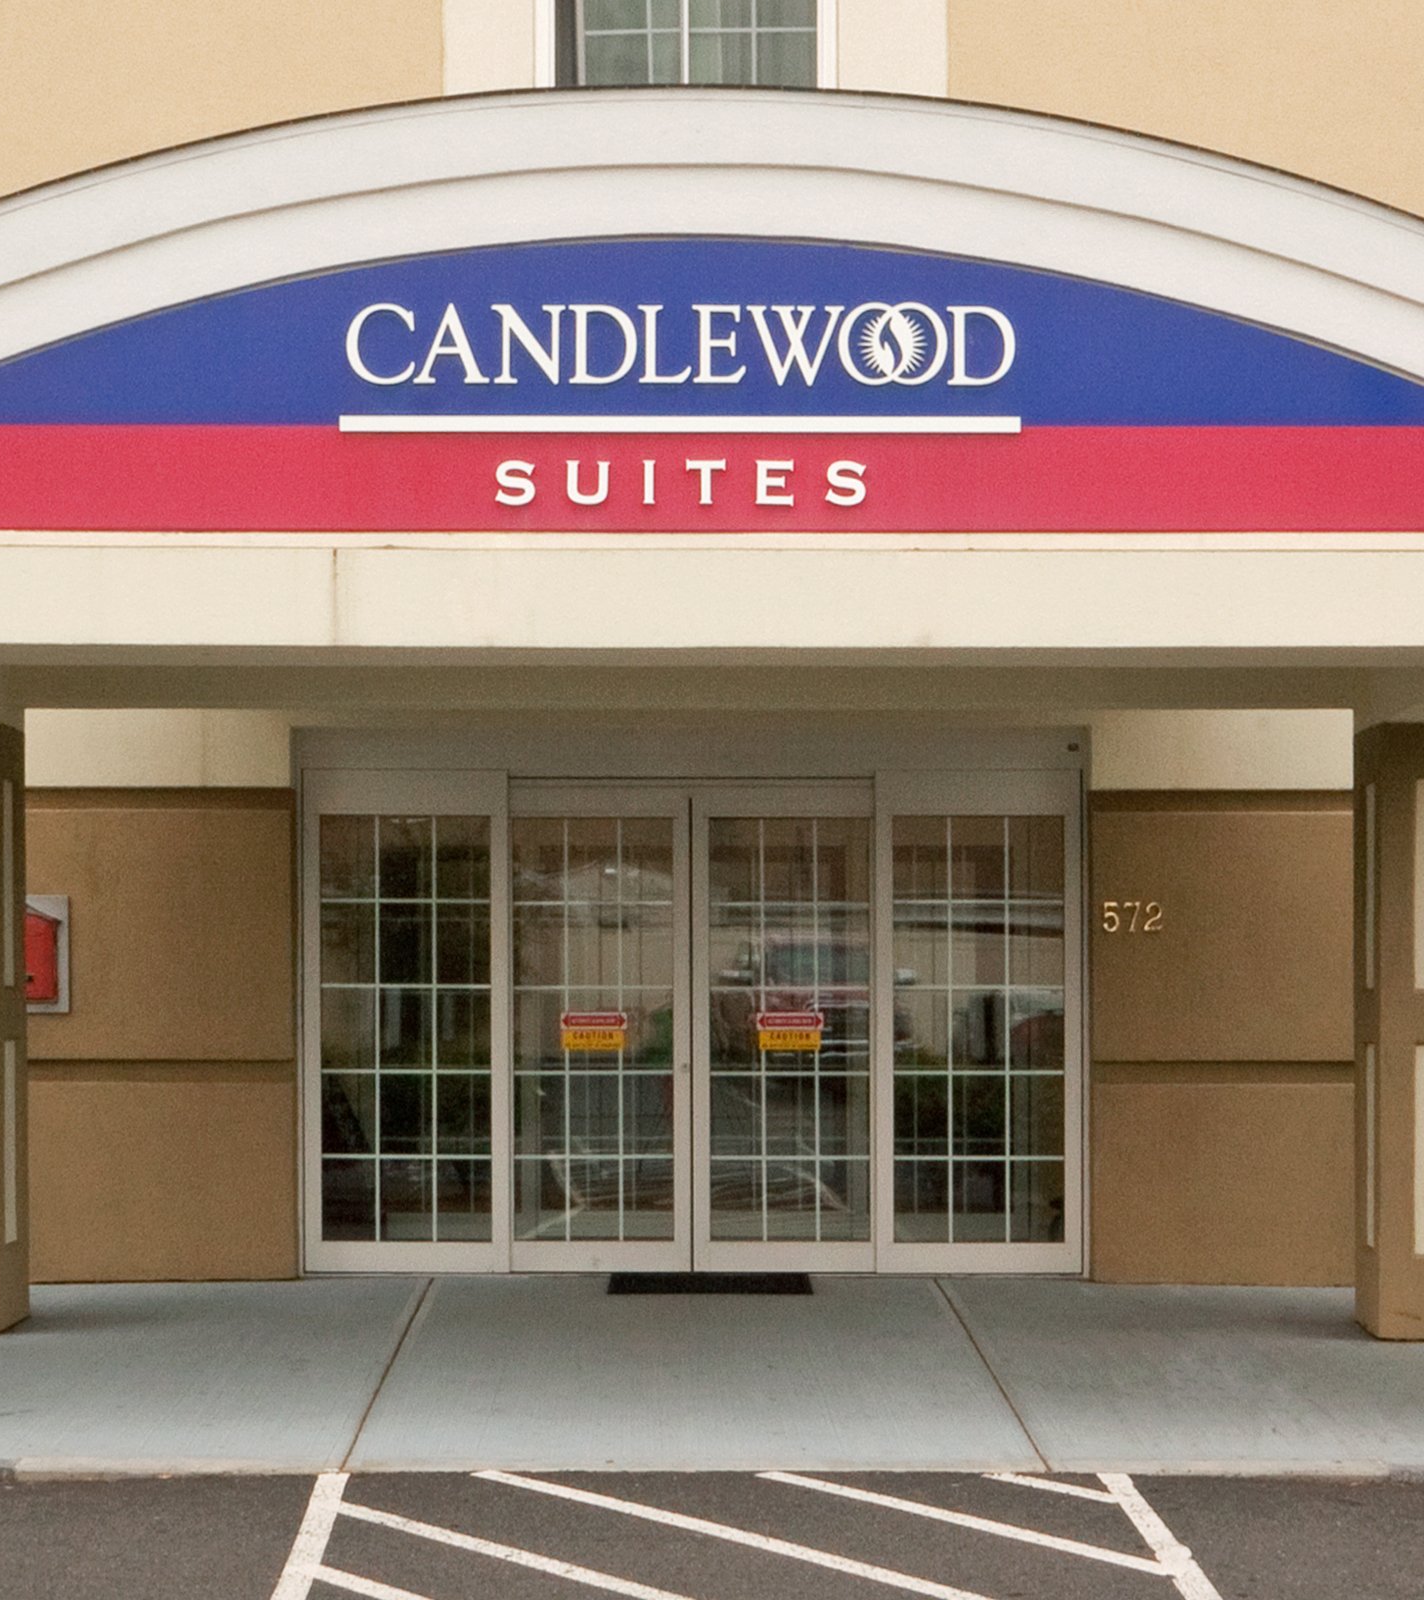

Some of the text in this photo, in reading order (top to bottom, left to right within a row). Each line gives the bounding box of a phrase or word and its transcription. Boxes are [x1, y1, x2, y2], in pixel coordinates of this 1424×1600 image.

[345, 302, 1016, 387] CANDLEWOOD
[494, 459, 867, 507] SUITES
[1103, 901, 1163, 932] 572
[572, 1031, 614, 1040] CAUTION
[770, 1031, 812, 1040] CAUTION
